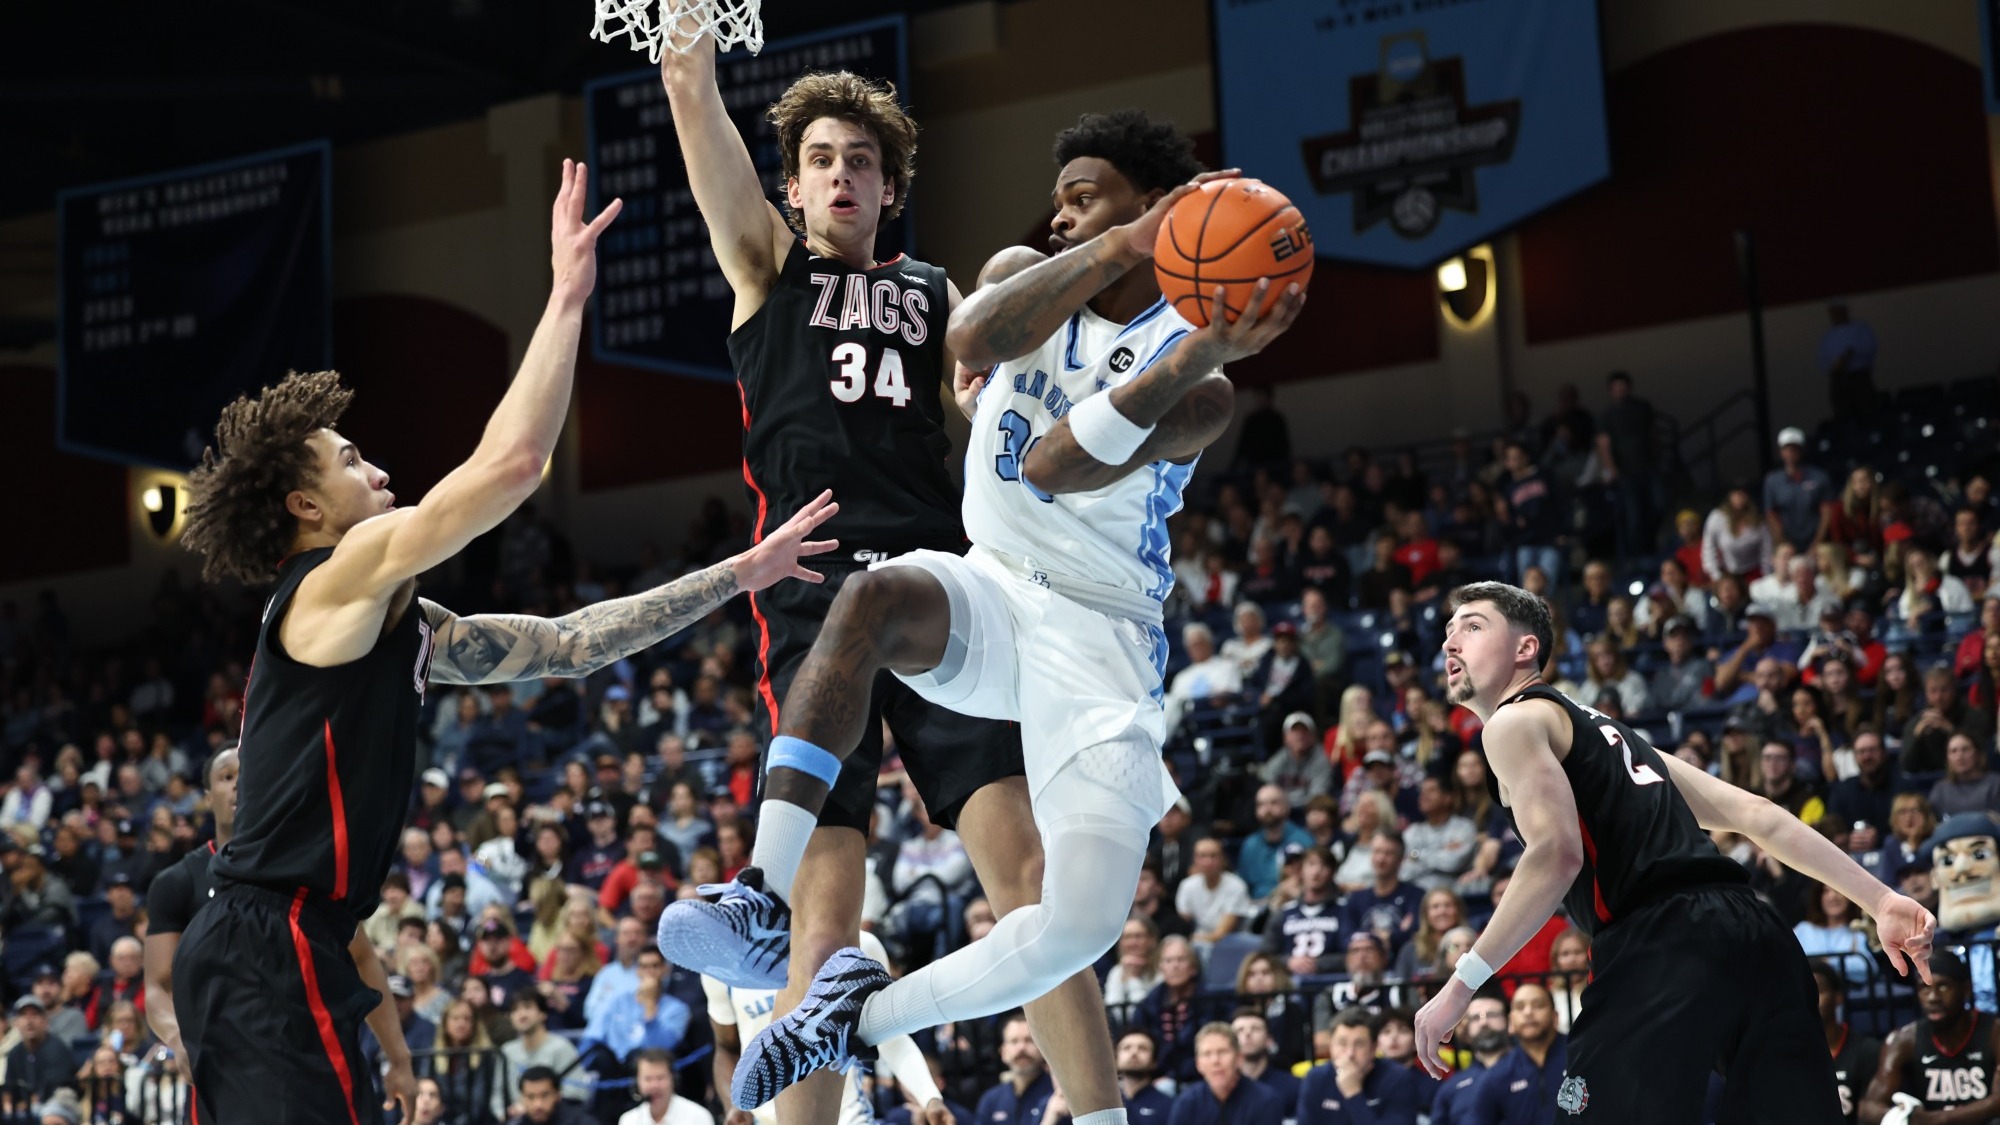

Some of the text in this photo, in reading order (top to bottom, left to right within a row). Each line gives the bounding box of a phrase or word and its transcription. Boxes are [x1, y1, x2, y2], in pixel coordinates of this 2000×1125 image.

[808, 272, 929, 347] ZAGS
[830, 341, 912, 407] 34
[1111, 352, 1133, 371] JC
[853, 549, 889, 564] GU
[1598, 724, 1665, 786] 2
[1924, 1066, 1988, 1101] ZAGS
